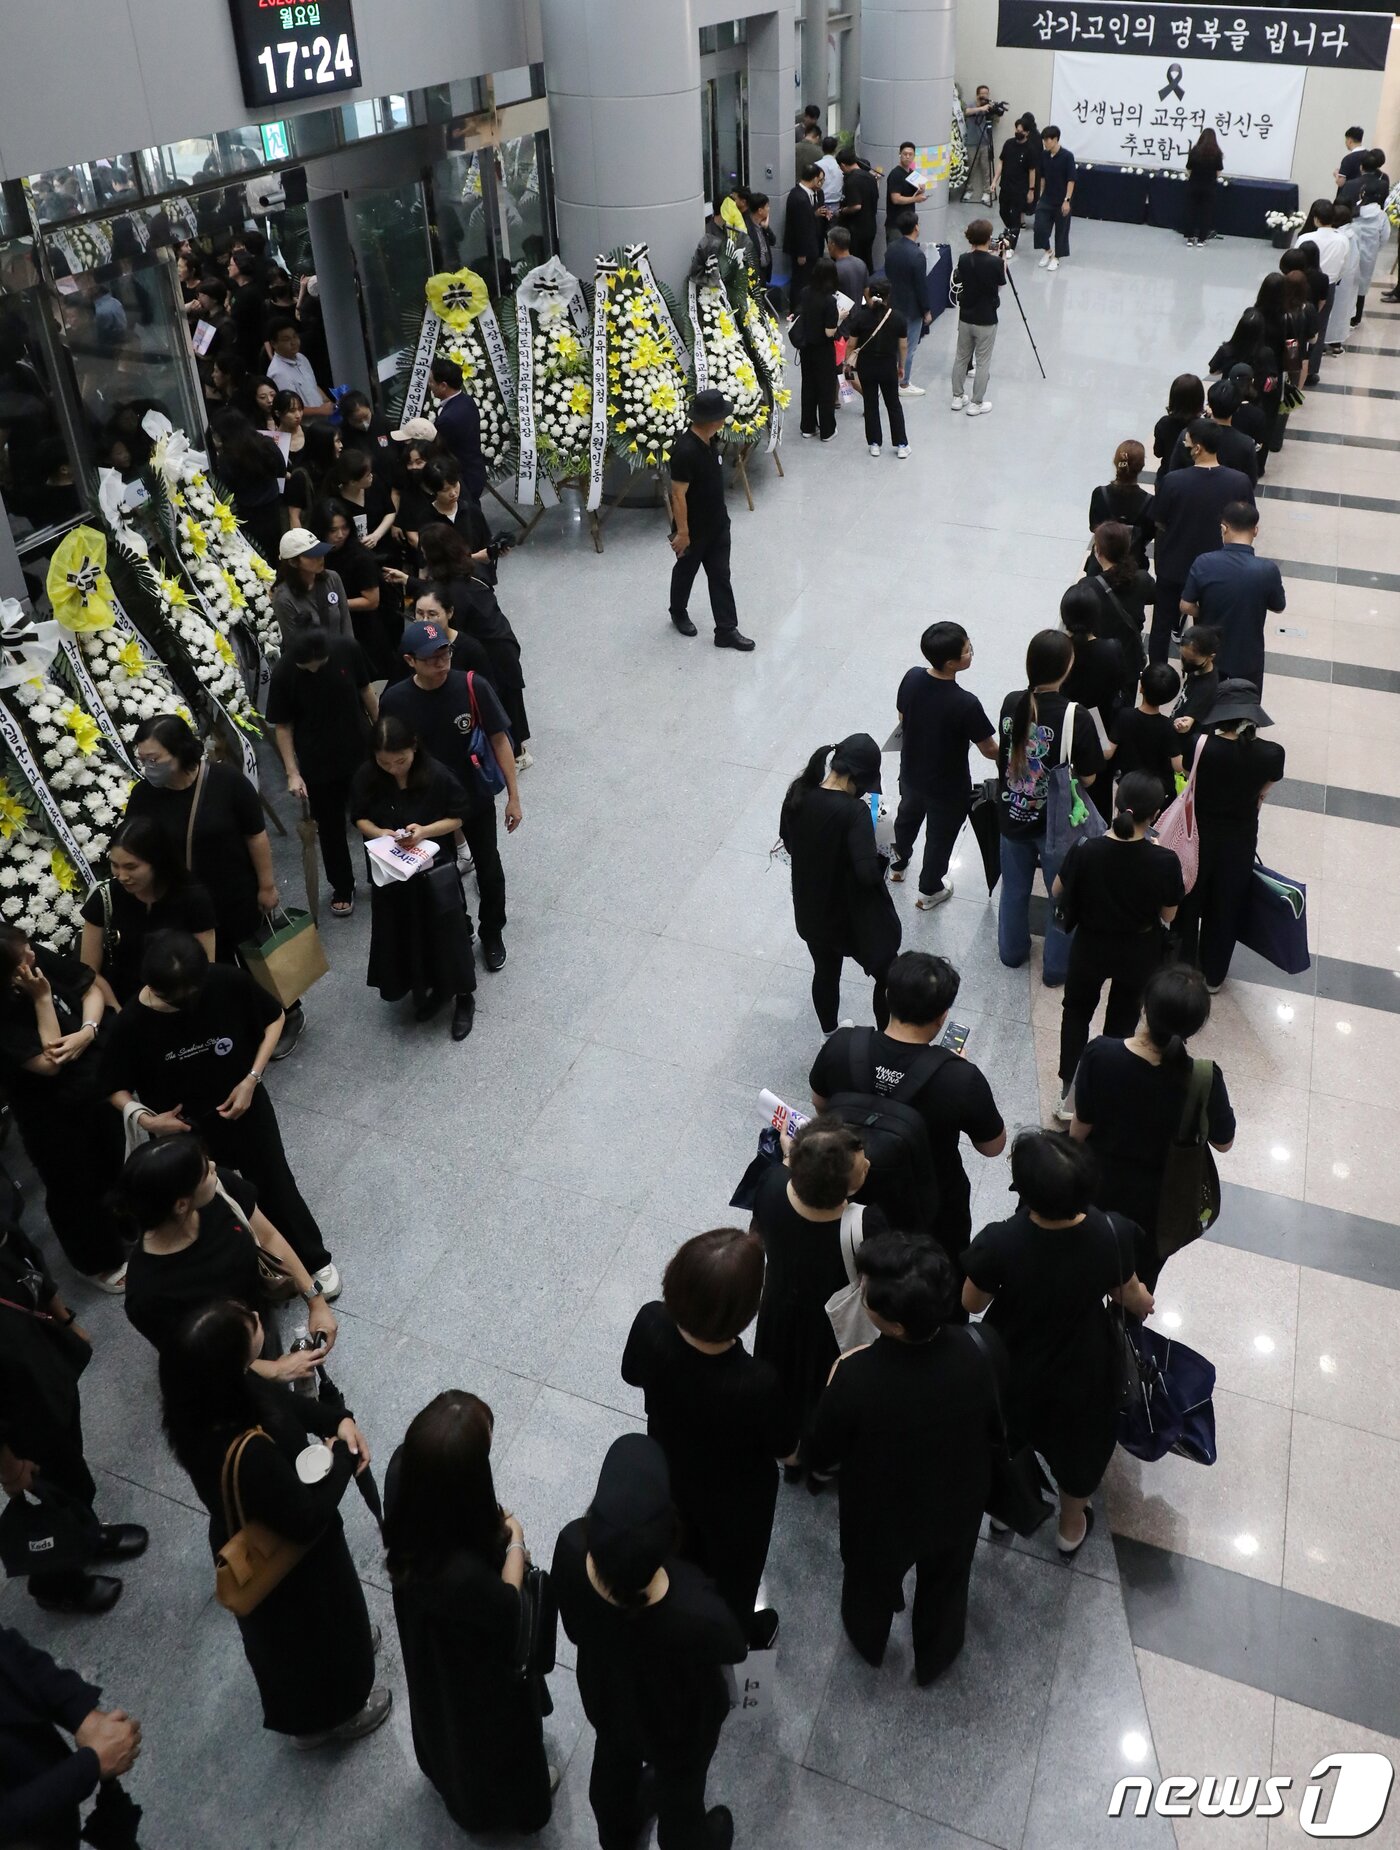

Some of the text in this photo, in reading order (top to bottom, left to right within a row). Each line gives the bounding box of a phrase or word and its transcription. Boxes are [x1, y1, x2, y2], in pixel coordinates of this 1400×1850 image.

[280, 4, 320, 29] 월요일
[1032, 10, 1349, 58] 삼가고인의 명복을 빕니다
[258, 34, 354, 94] 17:24
[1073, 99, 1274, 139] 선생님의 교육적 헌신을
